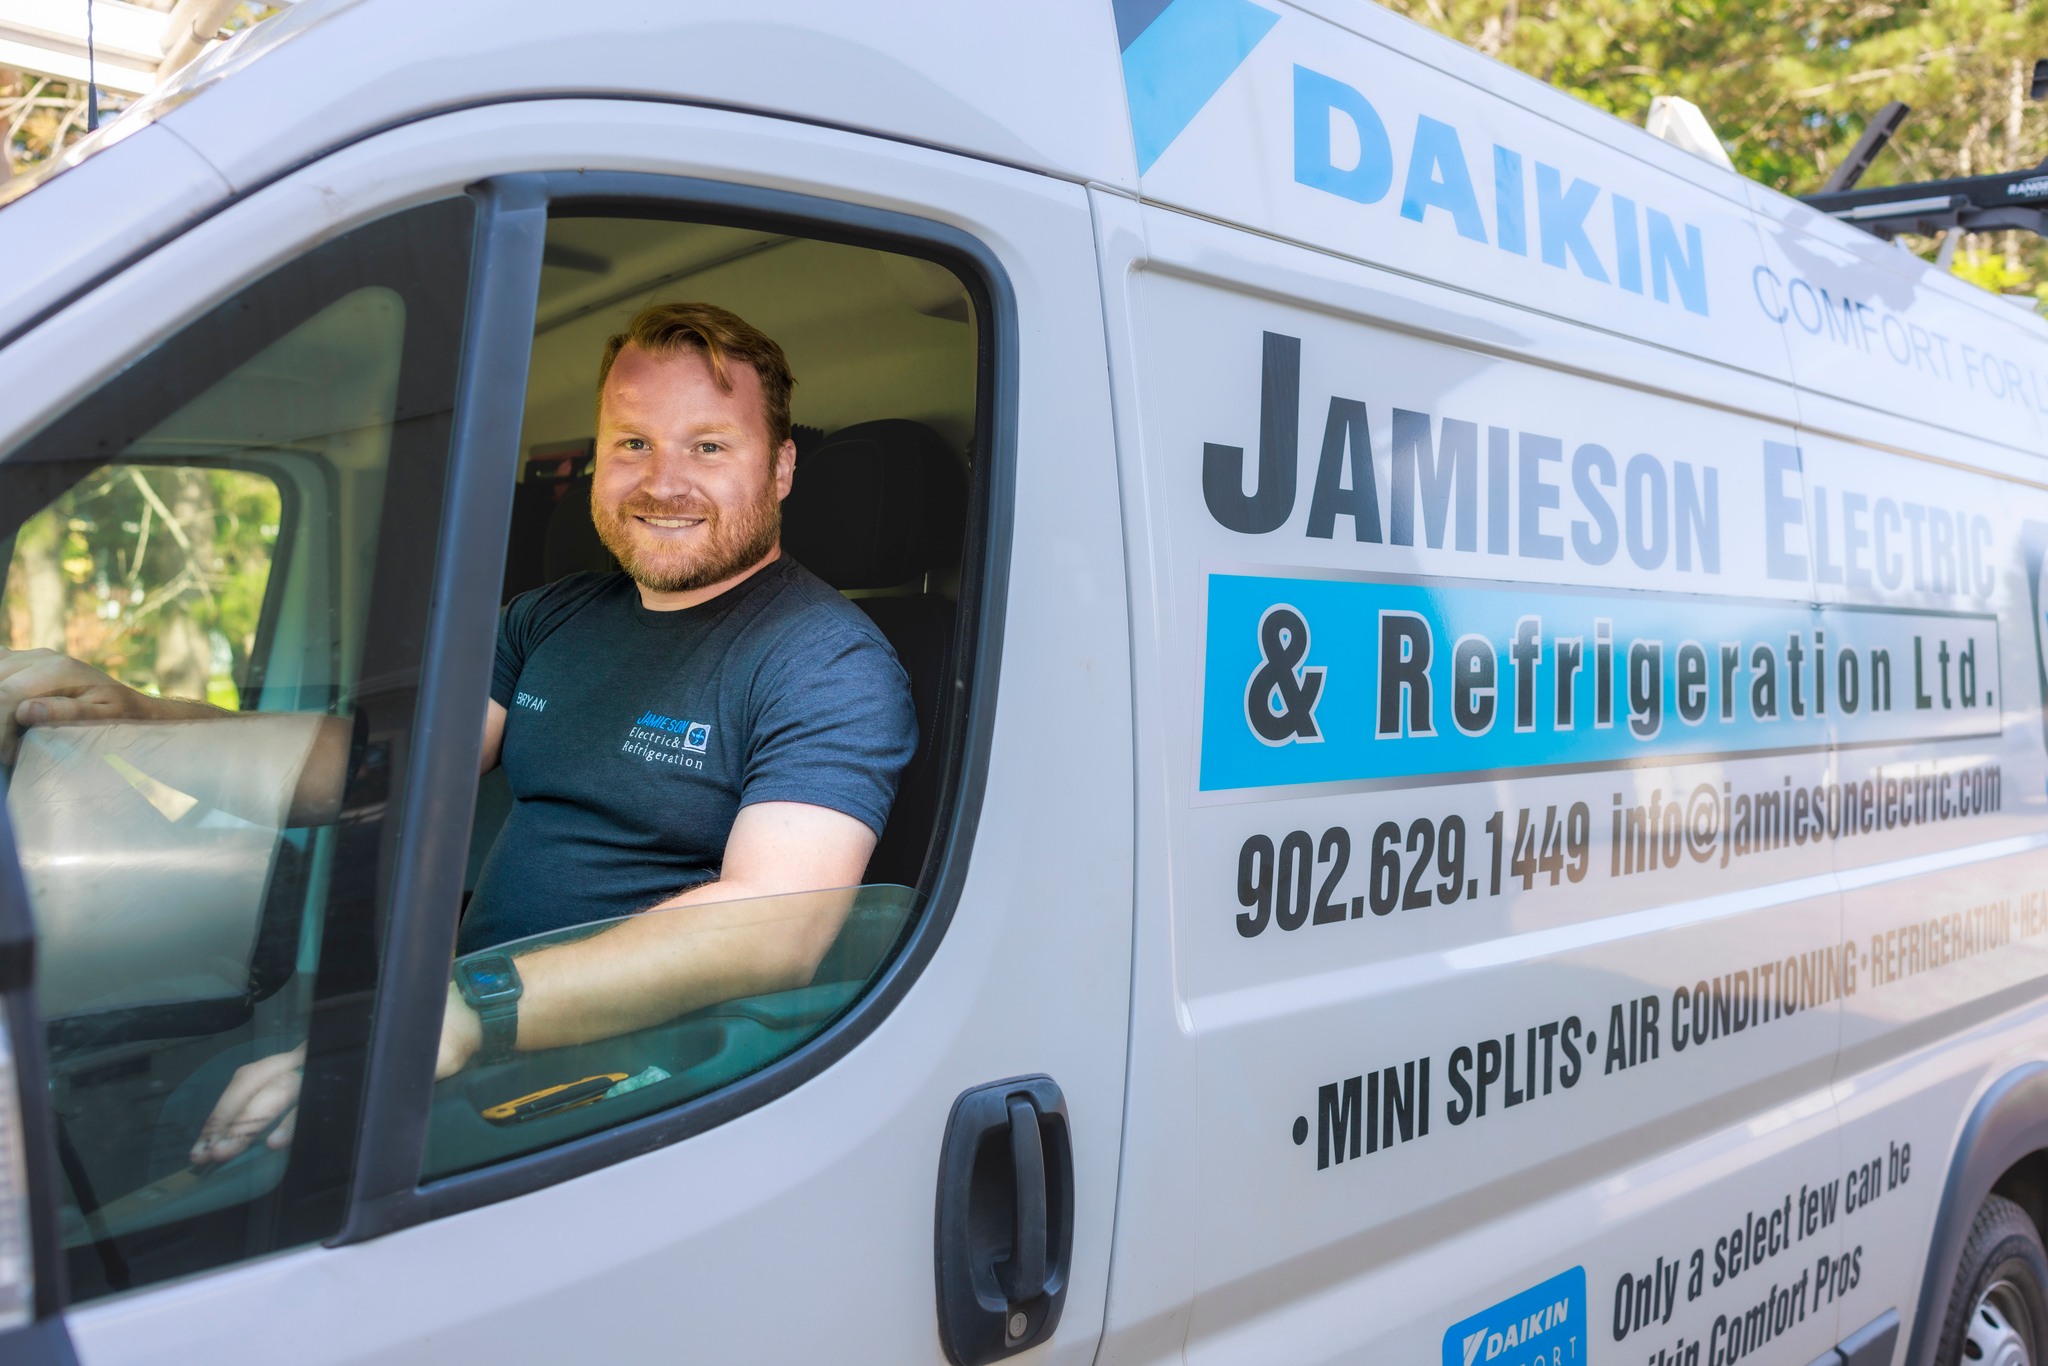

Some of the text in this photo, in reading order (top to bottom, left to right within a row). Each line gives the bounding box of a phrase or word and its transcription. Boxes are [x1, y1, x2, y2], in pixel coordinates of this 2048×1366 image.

[1294, 63, 1709, 317] DAIKIN
[1752, 264, 1952, 382] COMFORT
[1960, 342, 2030, 409] FOR
[1202, 330, 1996, 600] JAMIESON ELECTRIC
[516, 691, 547, 713] BRYAN
[637, 709, 689, 734] JAMIESON
[1244, 603, 1994, 748] & Refrigeration Ltd.
[622, 740, 704, 771] Refrigeration
[1235, 763, 2001, 939] 902.629.1449 info@jamiesonelectric.com
[1317, 1056, 1431, 1172] MINI
[1446, 1015, 1583, 1127] SPLITS
[1604, 995, 1660, 1076] AIR
[1671, 939, 1857, 1053] CONDITIONING
[1871, 897, 2011, 989] REFRIGERATION
[1612, 1139, 1912, 1343] Only a select few can be
[1707, 1244, 1864, 1366] Comfort Pros
[1485, 1296, 1570, 1362] DAIKIN
